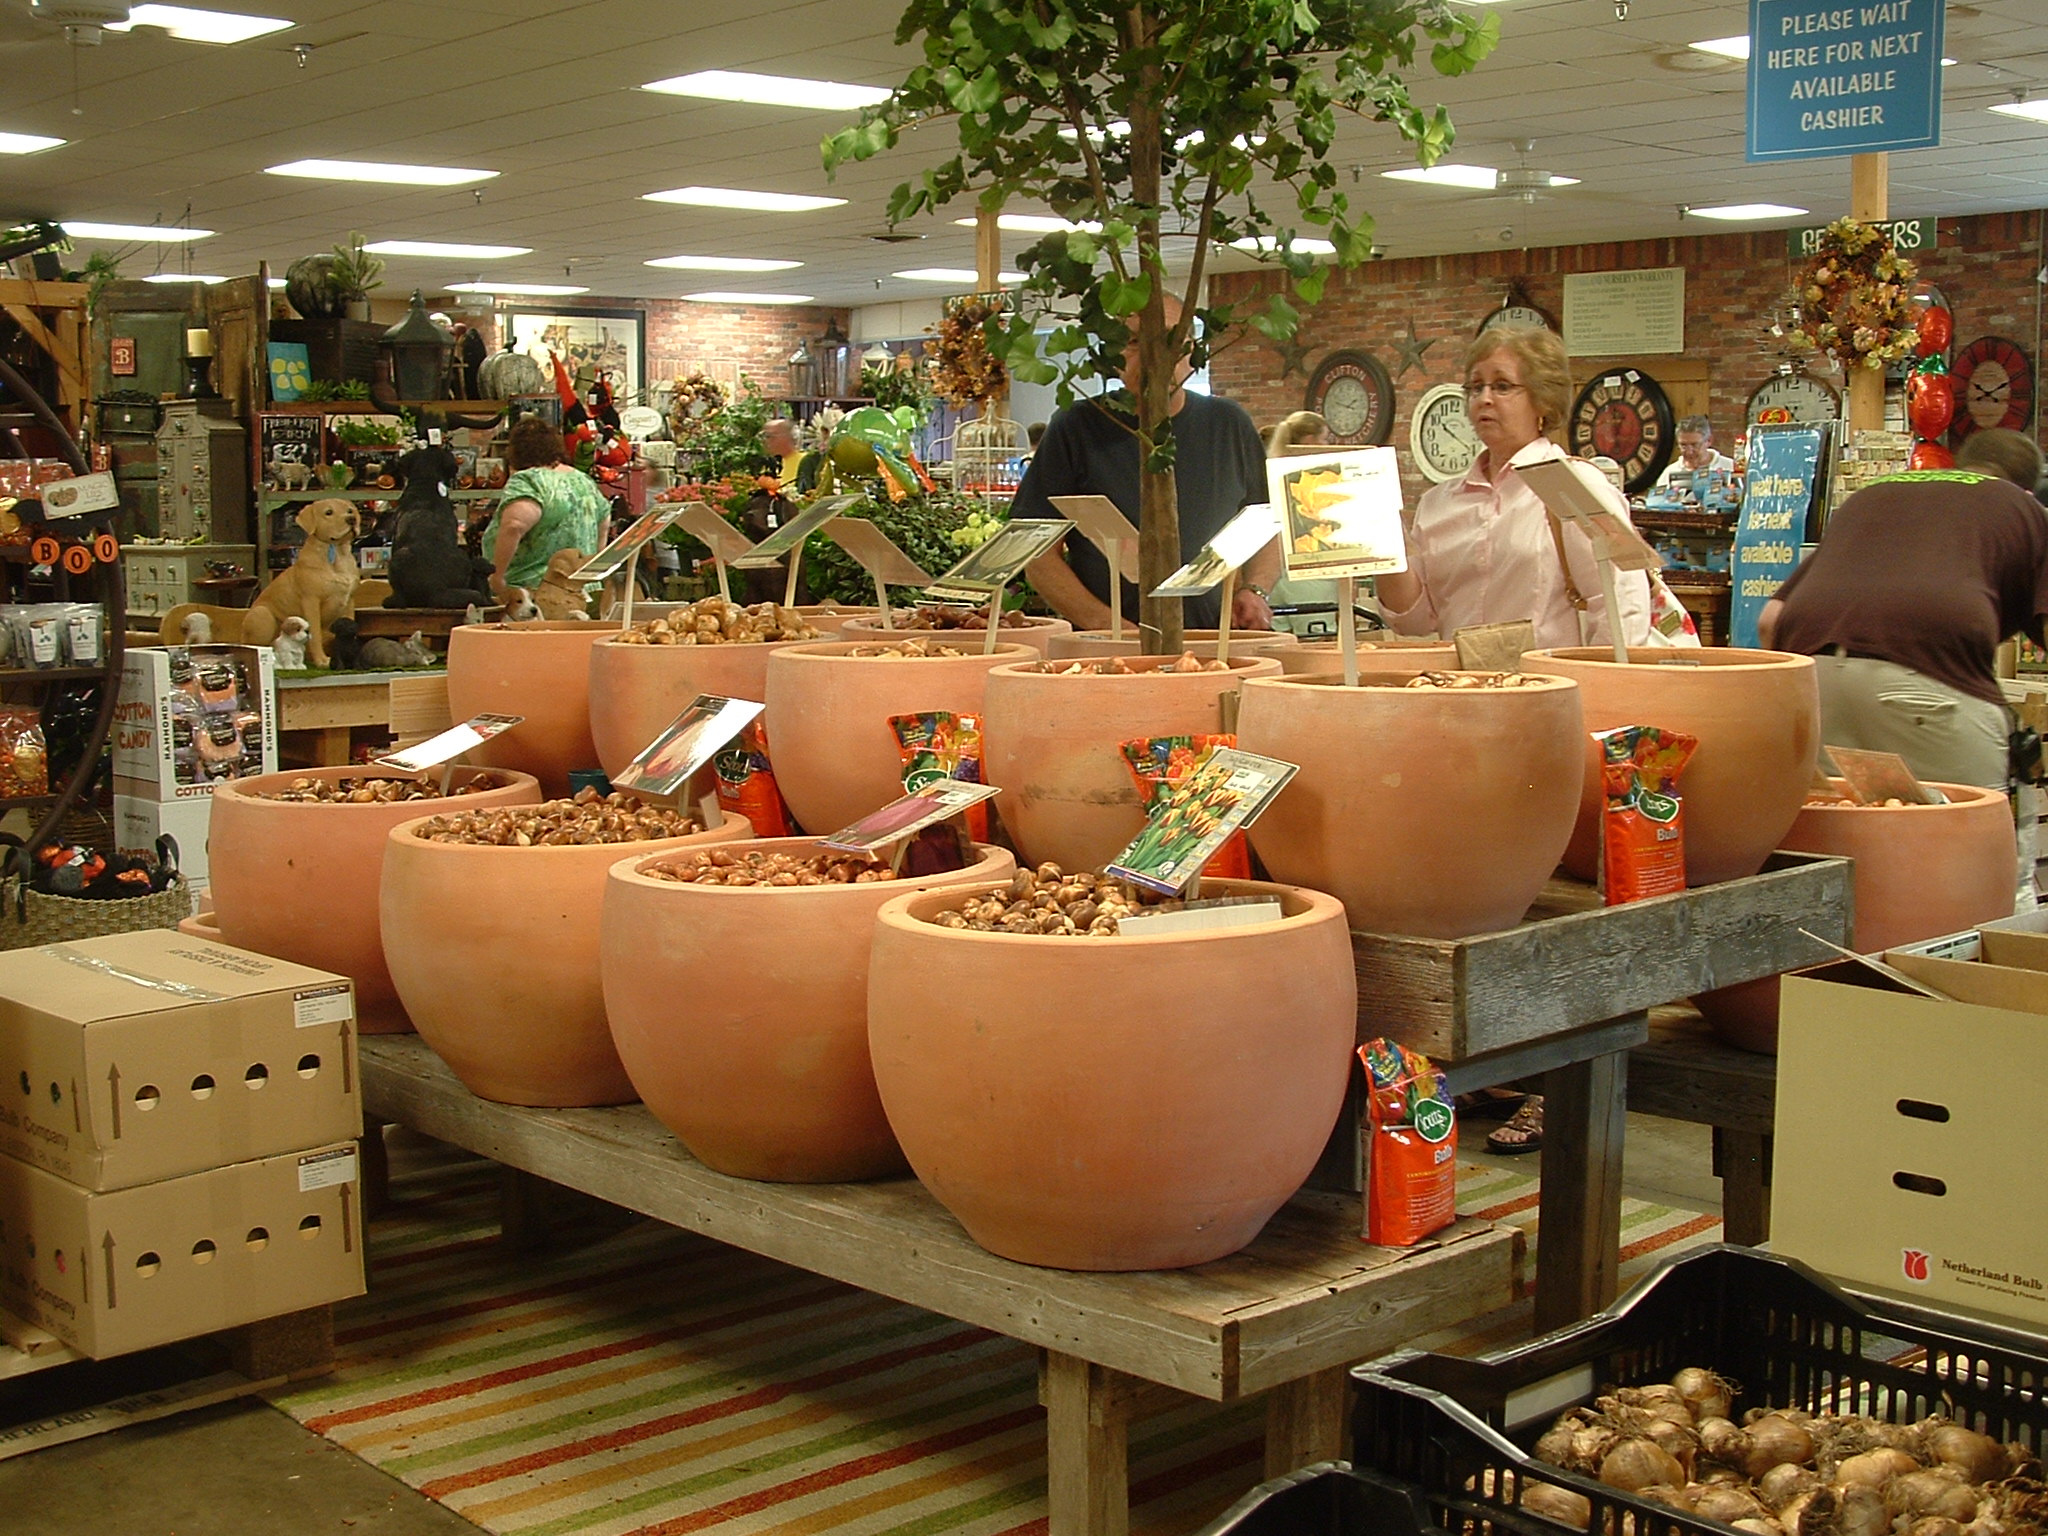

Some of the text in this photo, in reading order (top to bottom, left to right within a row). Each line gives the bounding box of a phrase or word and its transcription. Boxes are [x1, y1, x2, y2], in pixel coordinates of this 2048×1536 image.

[1781, 0, 1911, 36] PLEASE WAIT
[1767, 32, 1923, 69] HERE FOR NEXT
[1790, 70, 1896, 100] AVAILABLE
[1801, 105, 1884, 132] CASHIER
[115, 348, 131, 365] B
[1449, 400, 1461, 413] 12
[1427, 428, 1436, 441] 9
[1431, 443, 1440, 457] 8
[1449, 457, 1458, 470] 6
[1461, 453, 1469, 467] 5
[1774, 474, 1803, 496] here
[1741, 541, 1794, 565] available
[113, 701, 152, 722] COTTON
[264, 689, 273, 752] HAMMOND'S
[161, 696, 171, 760] HAMMOND'S
[119, 731, 152, 749] CANDY
[175, 785, 218, 797] COTTO
[1942, 1258, 2044, 1291] Netherland Bulb
